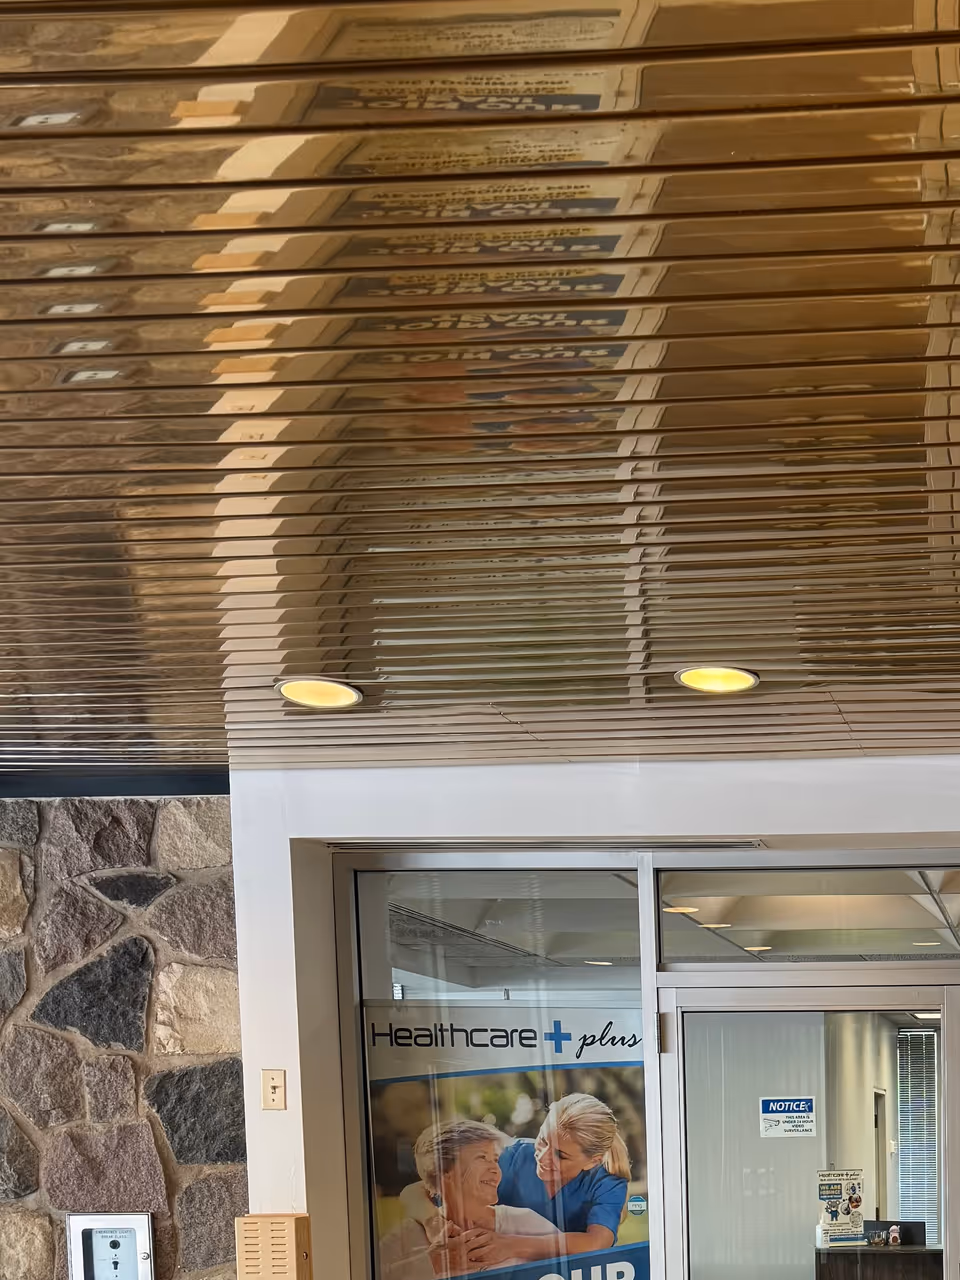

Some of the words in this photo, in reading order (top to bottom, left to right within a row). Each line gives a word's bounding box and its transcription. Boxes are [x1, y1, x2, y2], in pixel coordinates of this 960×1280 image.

[371, 1022, 538, 1048] Healthcare
[575, 1020, 643, 1060] plus
[769, 1101, 806, 1111] NOTICE
